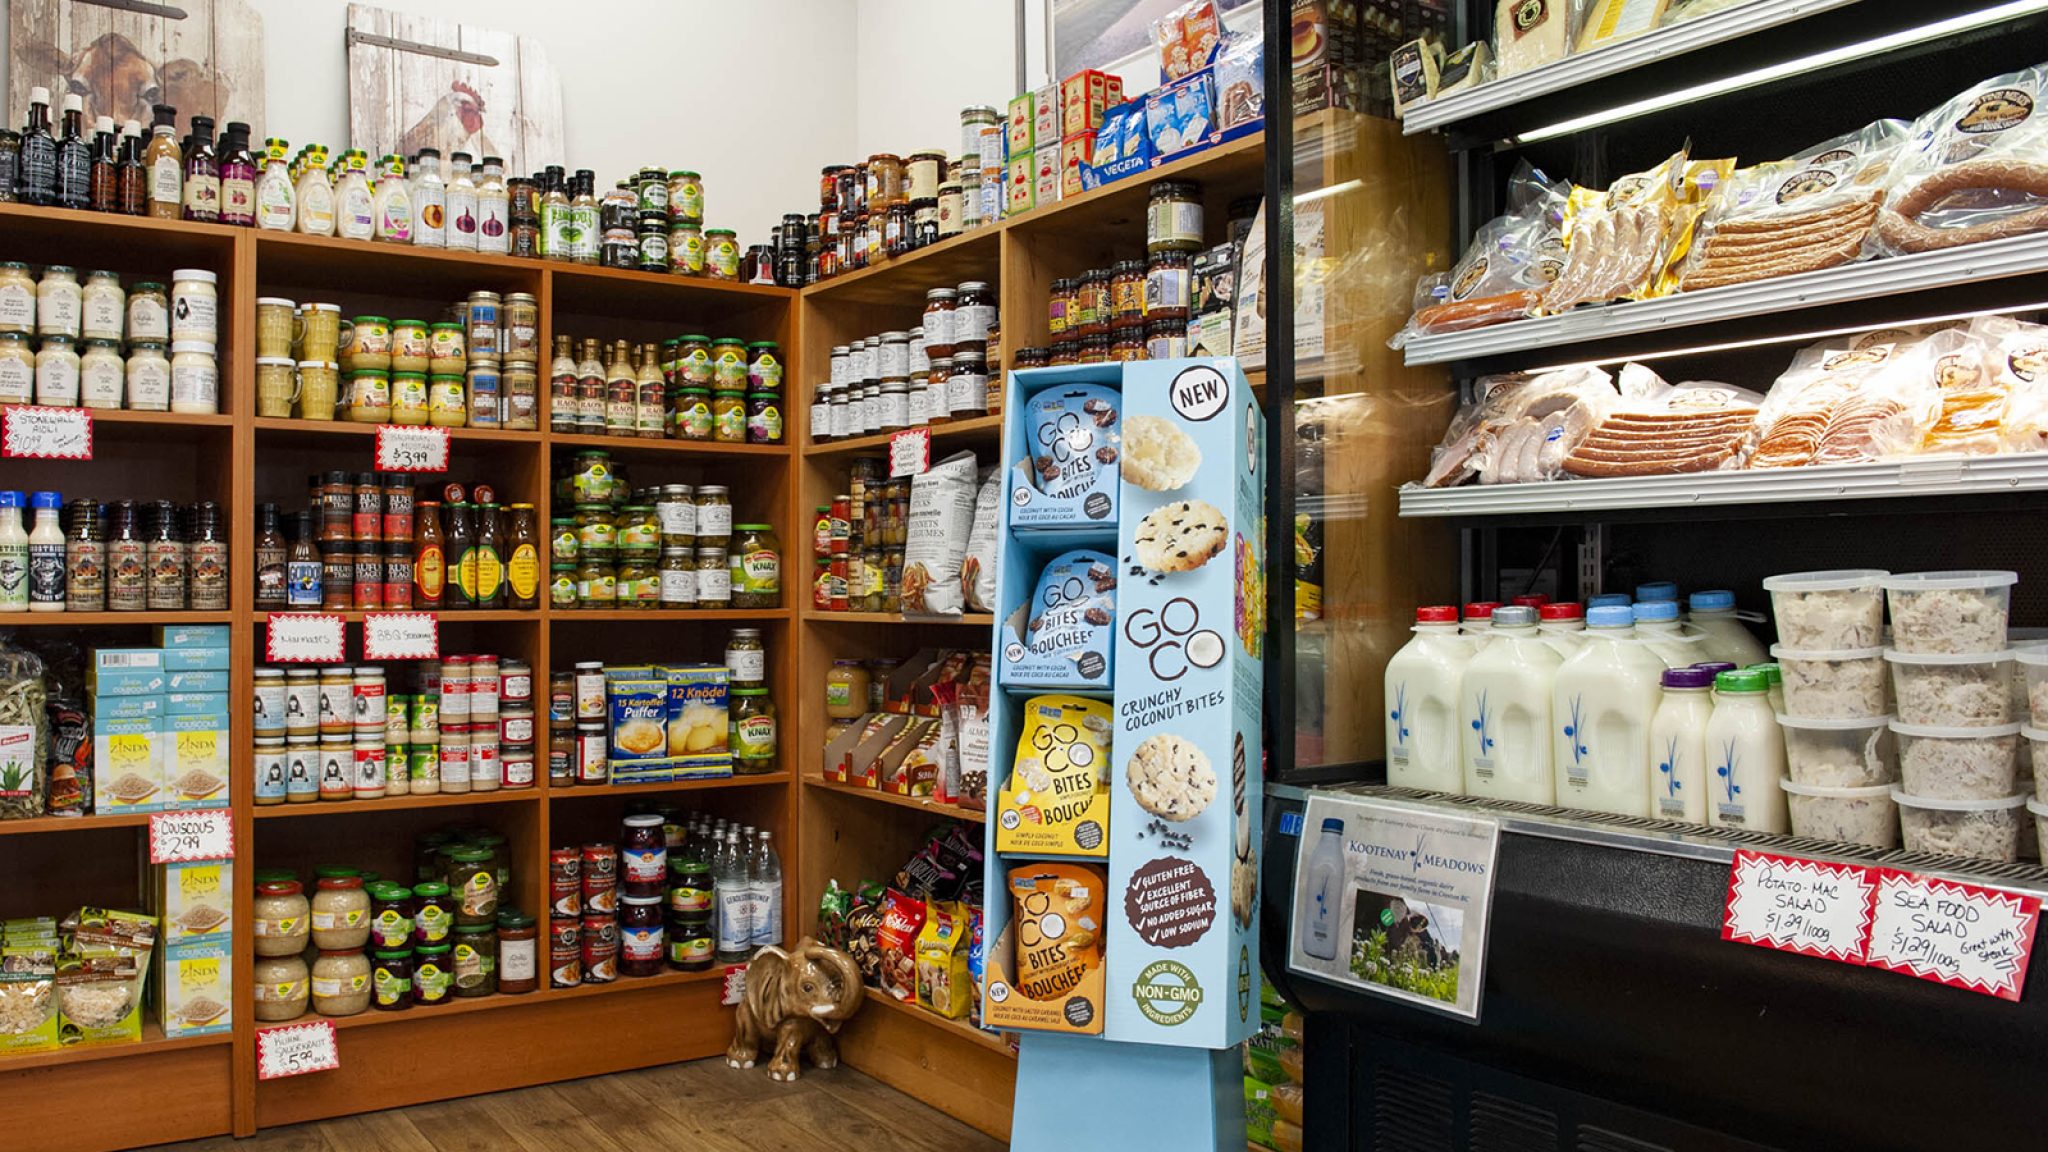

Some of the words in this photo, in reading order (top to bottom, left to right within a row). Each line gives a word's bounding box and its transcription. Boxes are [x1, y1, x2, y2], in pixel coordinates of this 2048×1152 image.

[1103, 157, 1144, 176] VEGETA
[1179, 379, 1218, 408] NEW
[1038, 412, 1079, 447] GO
[1062, 455, 1092, 481] BITES
[752, 561, 776, 571] KNAX
[1043, 577, 1084, 608] GO
[1045, 610, 1078, 631] BITES
[1125, 597, 1199, 648] GO
[618, 699, 627, 707] 15
[672, 688, 684, 698] 12
[687, 687, 727, 699] Knödel
[1121, 687, 1182, 716] CRUNCHY
[624, 707, 659, 718] Puffer
[1126, 703, 1183, 731] COCONUT
[1186, 690, 1225, 713] BITES
[748, 727, 772, 737] KNAX
[1032, 723, 1078, 750] GO
[1044, 742, 1094, 772] CO
[1053, 772, 1091, 795] BITES
[161, 820, 215, 835] COUSCOUS
[1349, 840, 1408, 861] KOOTENAY
[1424, 854, 1485, 875] MEADOWS
[1143, 869, 1172, 888] GLUTEN
[1174, 864, 1195, 878] FREE
[1140, 897, 1170, 914] SOURCE
[1170, 895, 1179, 905] OF
[1181, 888, 1206, 902] FIBER
[1147, 880, 1191, 901] EXCELLENT
[1147, 917, 1158, 927] NO
[1159, 908, 1184, 925] ADDED
[1186, 901, 1214, 918] SUGAR
[1775, 894, 1827, 913] SALAD
[1894, 891, 1929, 910] SEA
[1937, 900, 1979, 922] FOOD
[1160, 926, 1177, 939] LOW
[1179, 918, 1209, 934] SODIUM
[1911, 913, 1967, 938] SALAD
[1960, 939, 1986, 954] Great
[1990, 929, 2014, 944] with
[1028, 944, 1066, 970] BITES
[1978, 945, 2013, 962] steak
[1144, 963, 1168, 980] MADE
[1170, 963, 1191, 982] WITH
[991, 989, 1006, 998] NEW
[1135, 984, 1200, 1002] NON-GMO
[1142, 1003, 1193, 1024] INGREDIENTS
